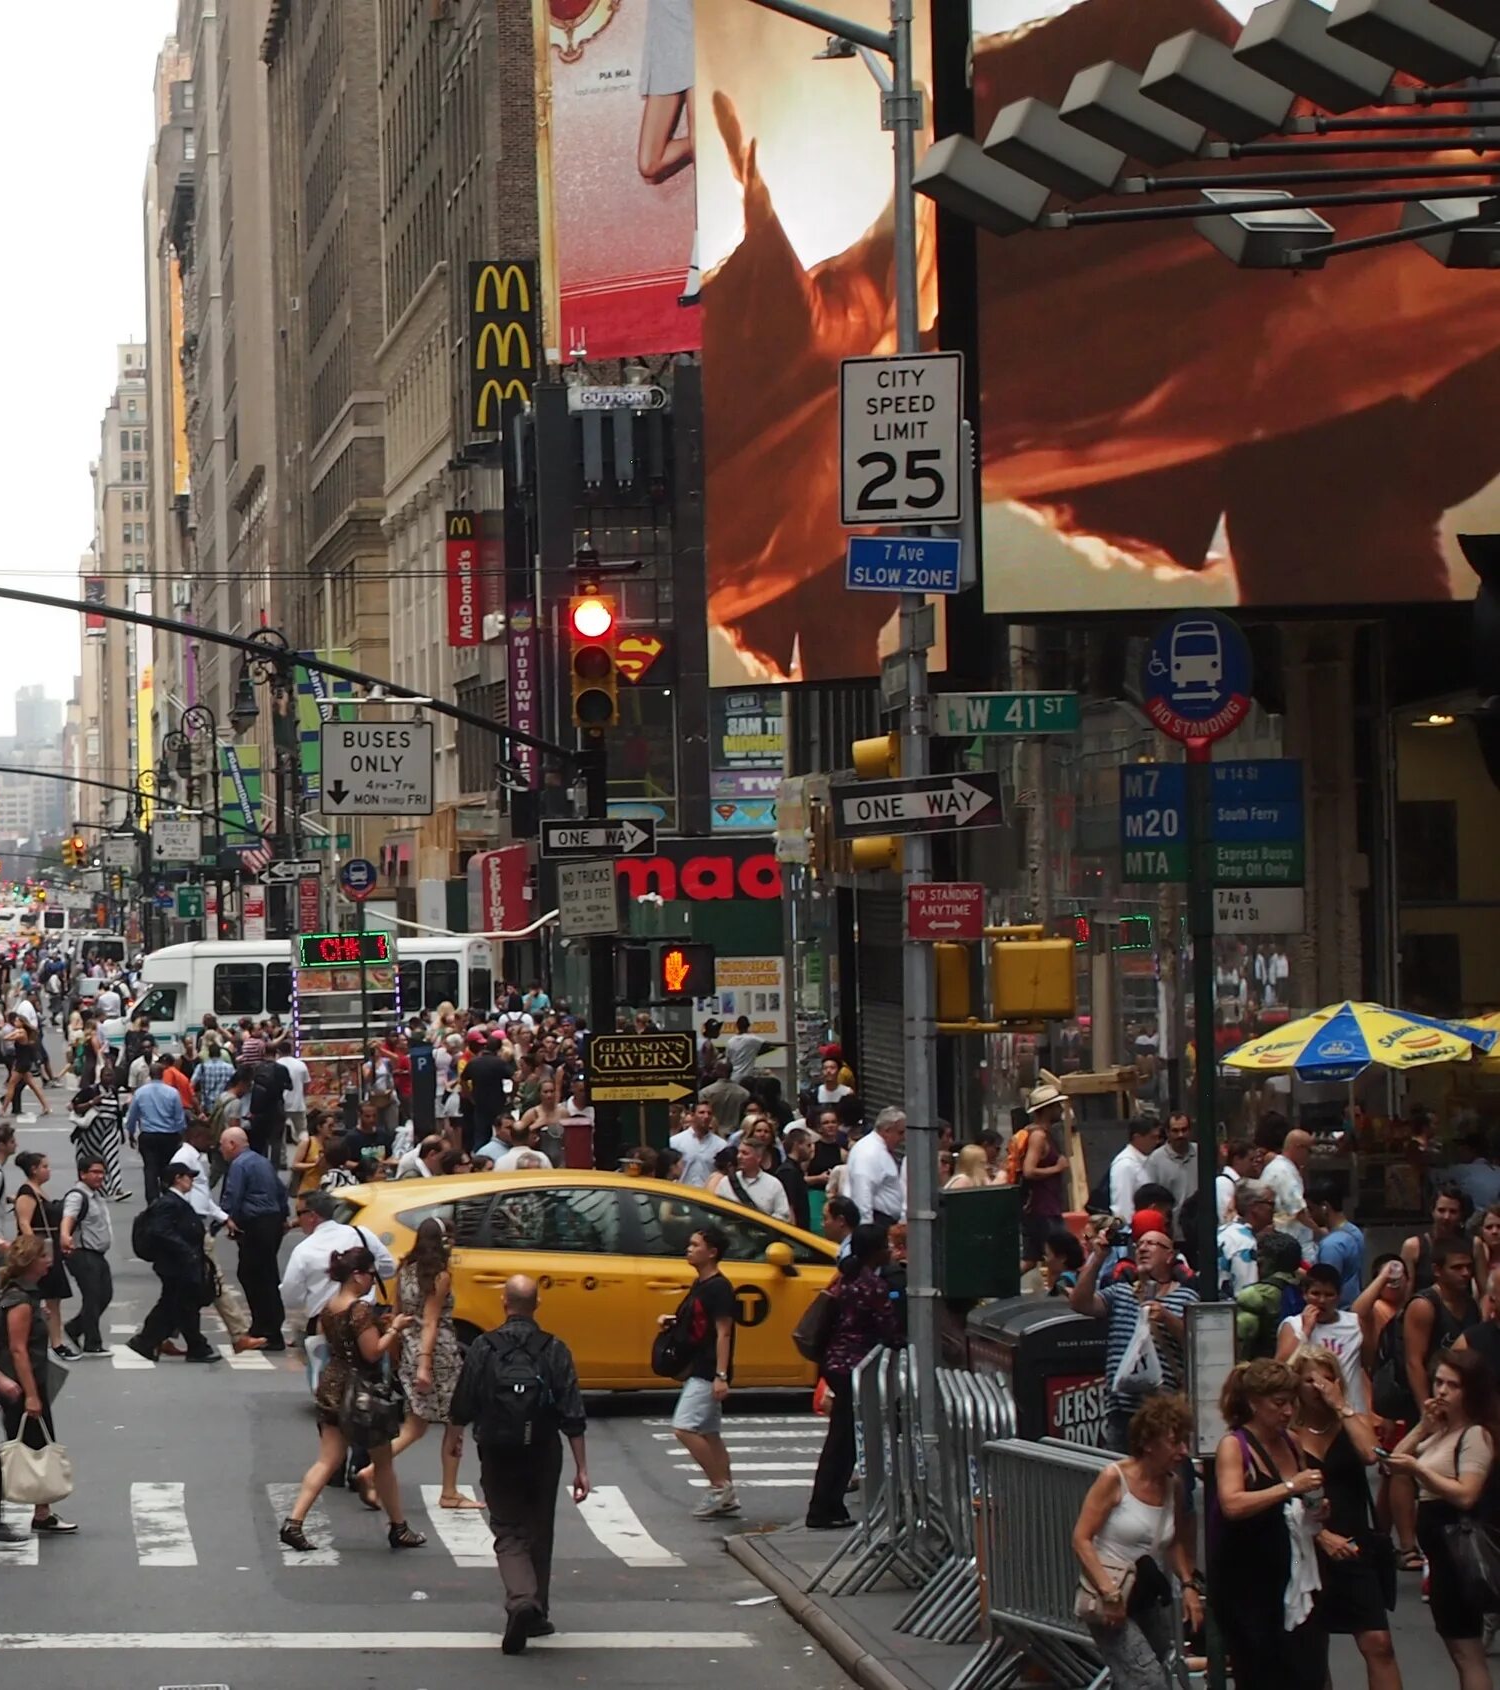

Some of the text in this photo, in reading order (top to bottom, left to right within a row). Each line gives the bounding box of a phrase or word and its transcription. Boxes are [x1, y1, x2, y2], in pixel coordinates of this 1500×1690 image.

[877, 369, 926, 388] CITY
[866, 395, 936, 415] SPEED
[874, 421, 928, 441] LIMIT
[856, 449, 945, 510] 25
[884, 545, 925, 562] 7 Ave
[853, 567, 953, 587] SLOW ZONE
[457, 549, 473, 640] McDonald's
[514, 636, 532, 711] MIDTOWN
[967, 698, 1065, 730] W 41 ST
[1152, 700, 1241, 736] NO STANDING
[727, 718, 762, 736] 8AM
[343, 731, 411, 748] BUSES
[350, 755, 404, 772] ONLY
[1125, 770, 1160, 798] M7
[354, 795, 380, 805] MON
[407, 795, 427, 805] FRI
[856, 791, 975, 820] ONE WAY
[1126, 809, 1178, 837] M20
[1217, 807, 1278, 822] South Ferry
[558, 829, 638, 845] ONE WAY
[1126, 852, 1169, 874] MTA
[1217, 847, 1258, 862] Express
[1217, 863, 1243, 878] Drop
[1265, 862, 1291, 878] Only
[911, 888, 979, 901] NO STANDING
[1219, 892, 1225, 904] 7
[1227, 892, 1241, 904] Av
[920, 904, 971, 916] ANYTIME
[1218, 907, 1259, 920] W 41 St
[599, 1041, 685, 1053] GLEASON'S
[418, 1058, 427, 1070] P
[599, 1052, 684, 1067] TAVERN
